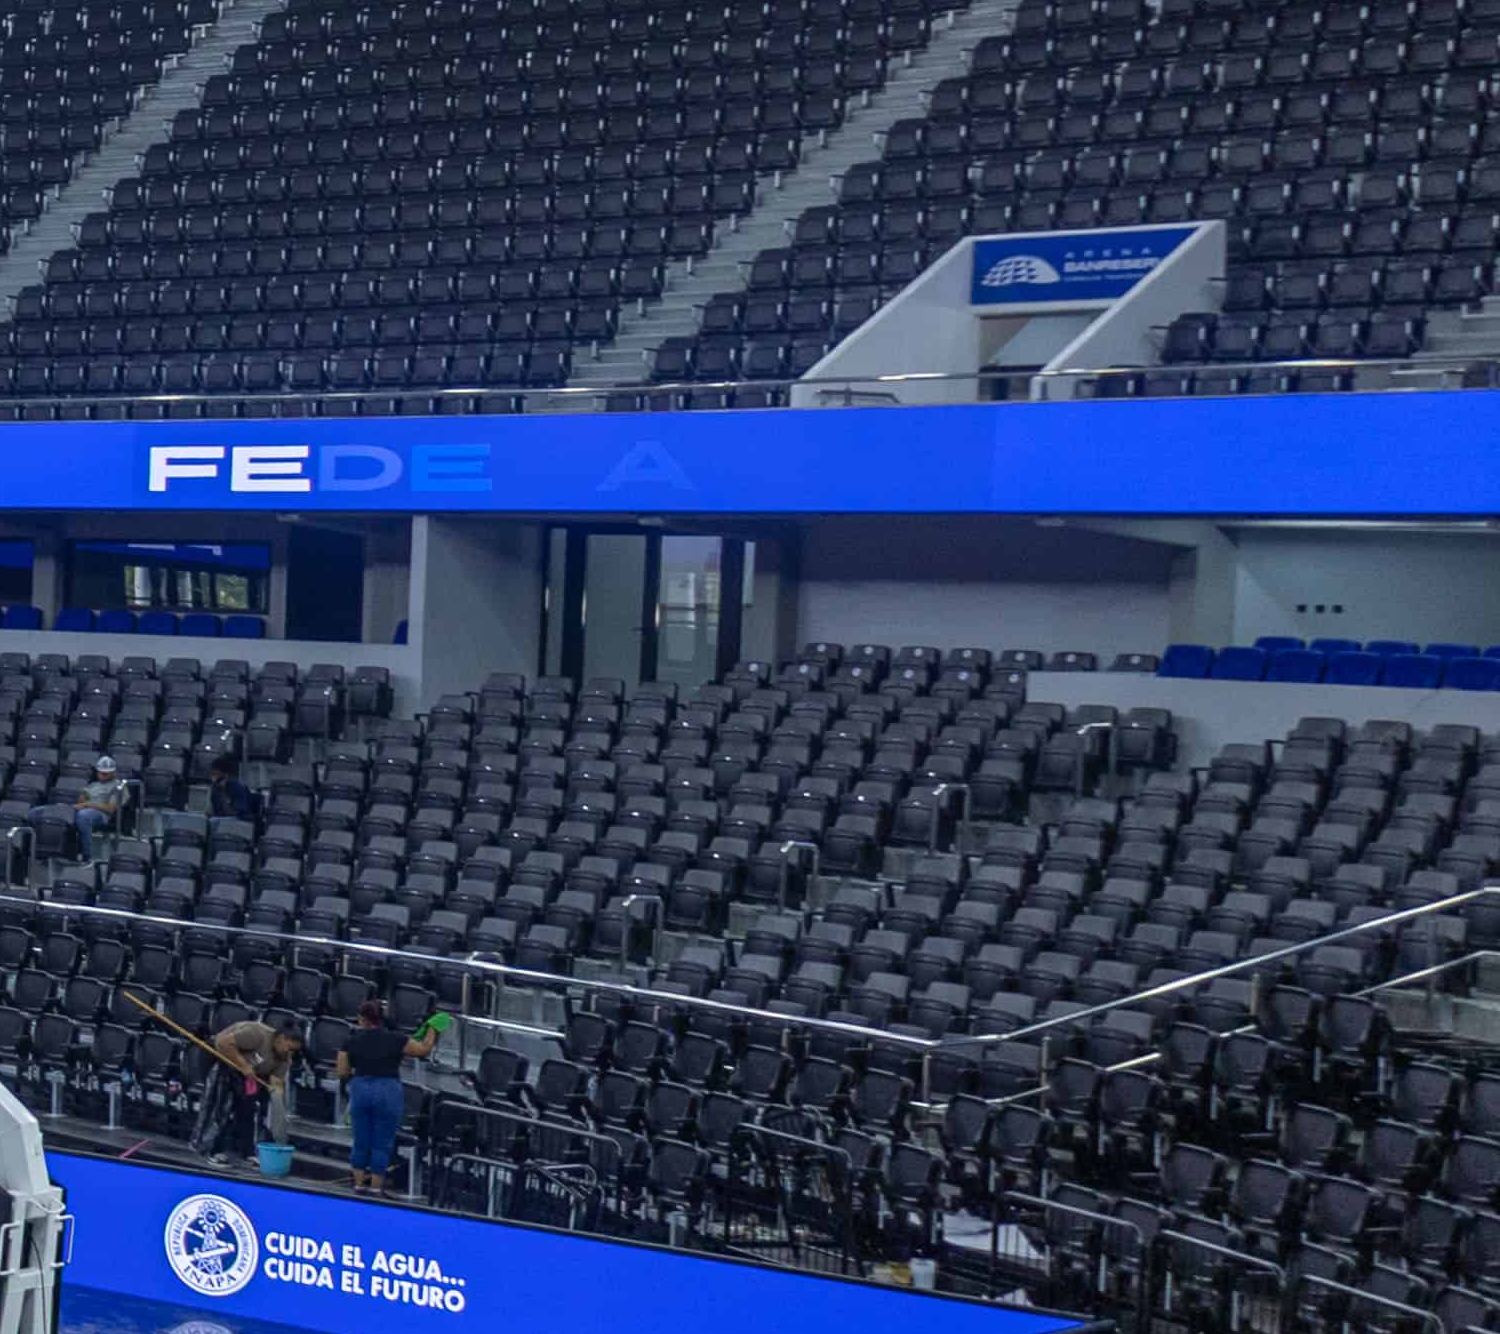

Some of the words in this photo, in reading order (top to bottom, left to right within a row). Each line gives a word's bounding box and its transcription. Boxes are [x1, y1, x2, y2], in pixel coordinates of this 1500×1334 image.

[182, 1263, 238, 1288] INAPA
[263, 1230, 336, 1265] CUIDA
[341, 1243, 366, 1269] EL
[371, 1250, 467, 1289] AGUA...
[263, 1257, 335, 1290] CUIDA
[340, 1269, 365, 1296] EL
[369, 1275, 467, 1314] FUTURO
